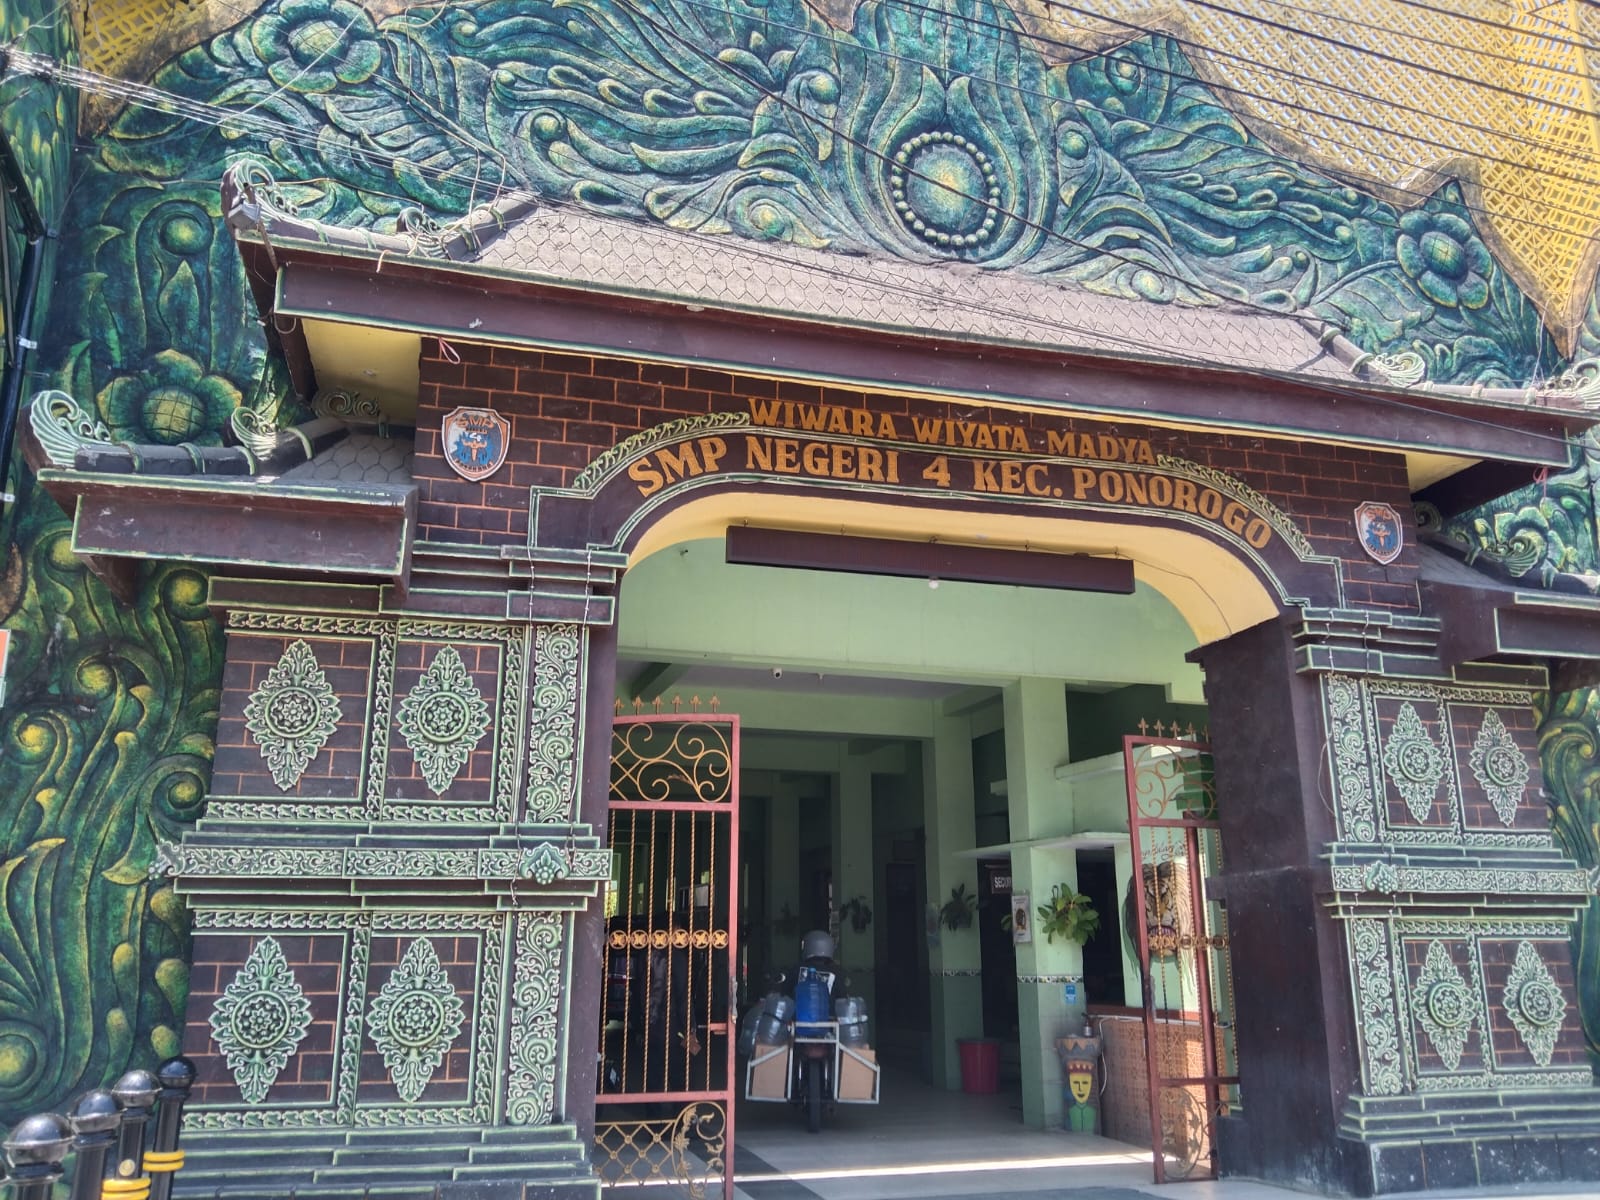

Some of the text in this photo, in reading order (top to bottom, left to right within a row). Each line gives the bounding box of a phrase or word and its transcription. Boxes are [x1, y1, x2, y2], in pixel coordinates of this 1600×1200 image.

[748, 398, 1157, 465] WIWARA WIYATA MADYA
[628, 435, 1273, 549] SMP NEGERI 4 KEC. PONOROGO
